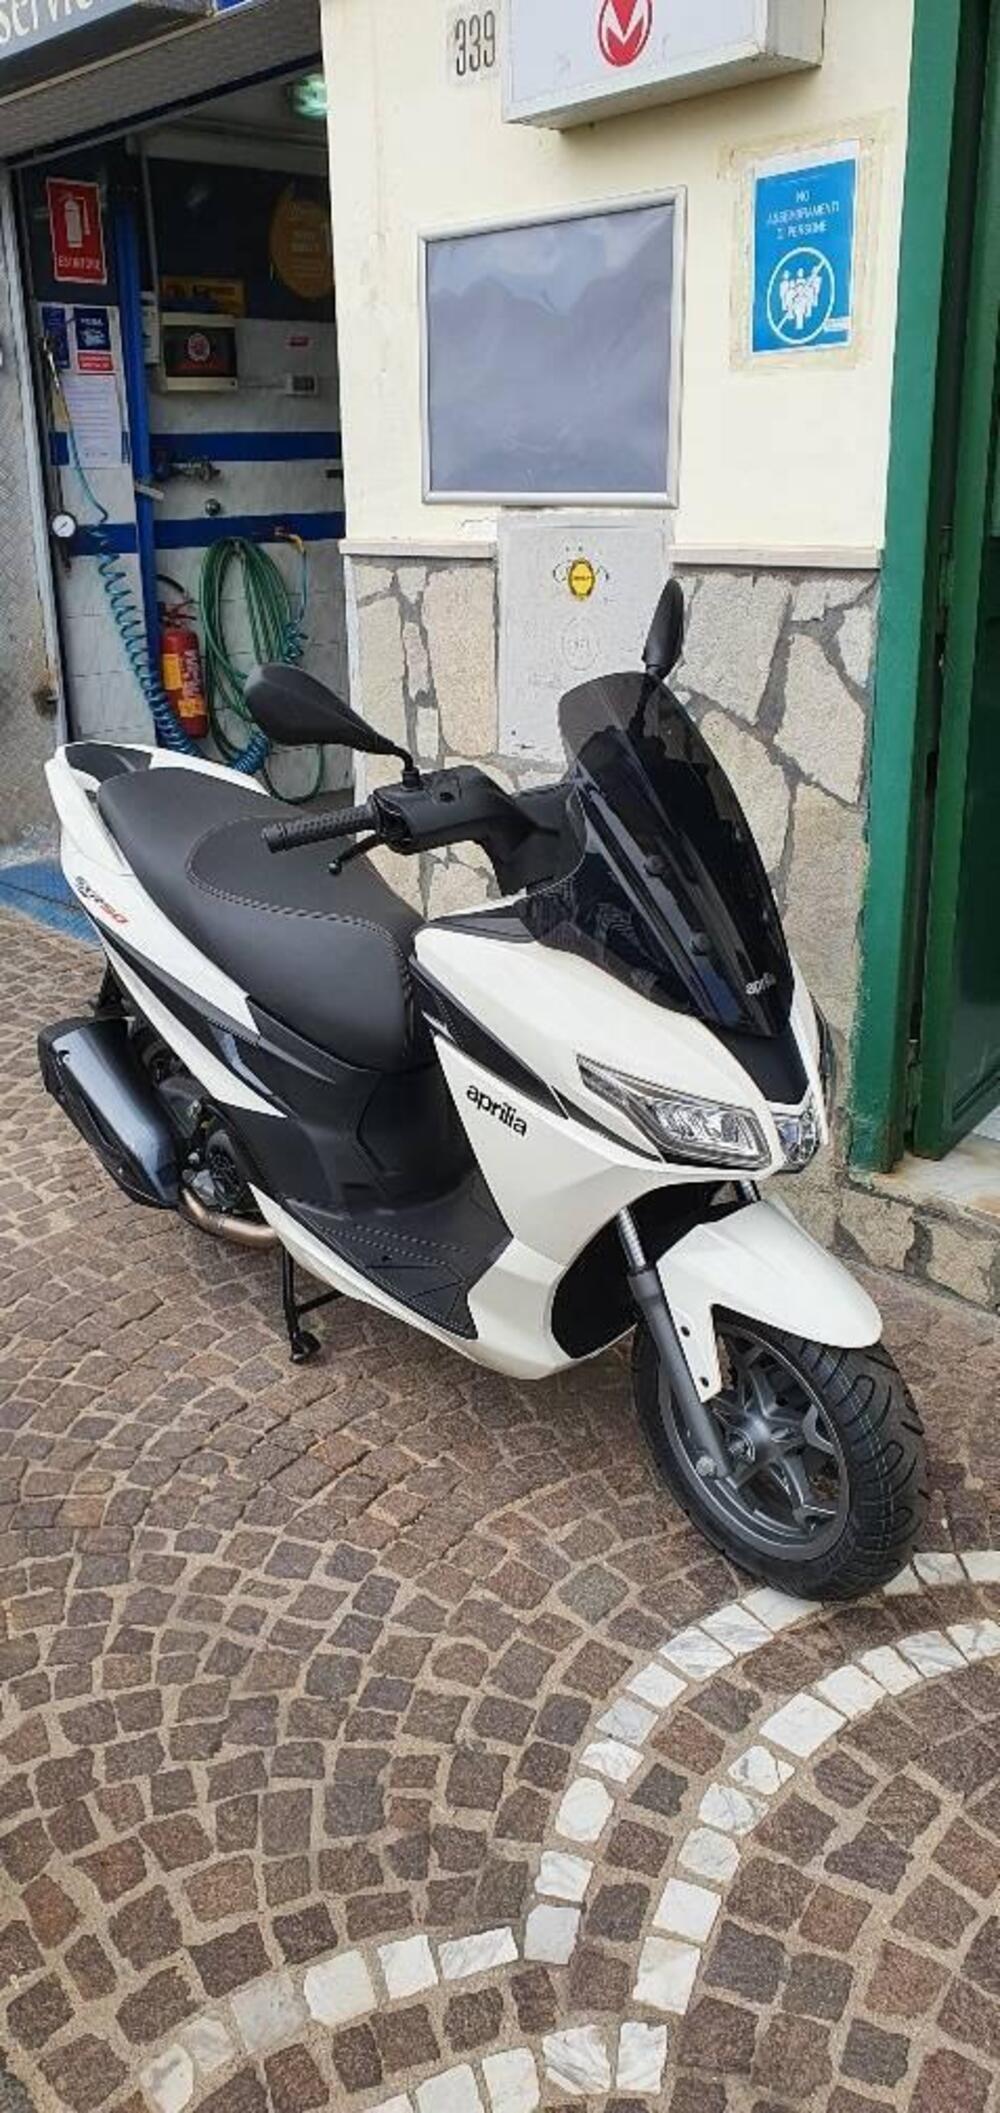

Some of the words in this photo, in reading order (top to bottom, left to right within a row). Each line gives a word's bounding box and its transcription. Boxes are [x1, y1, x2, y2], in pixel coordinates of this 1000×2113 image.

[454, 10, 496, 76] 339
[795, 190, 811, 203] NO
[466, 1084, 528, 1137] aprilia
